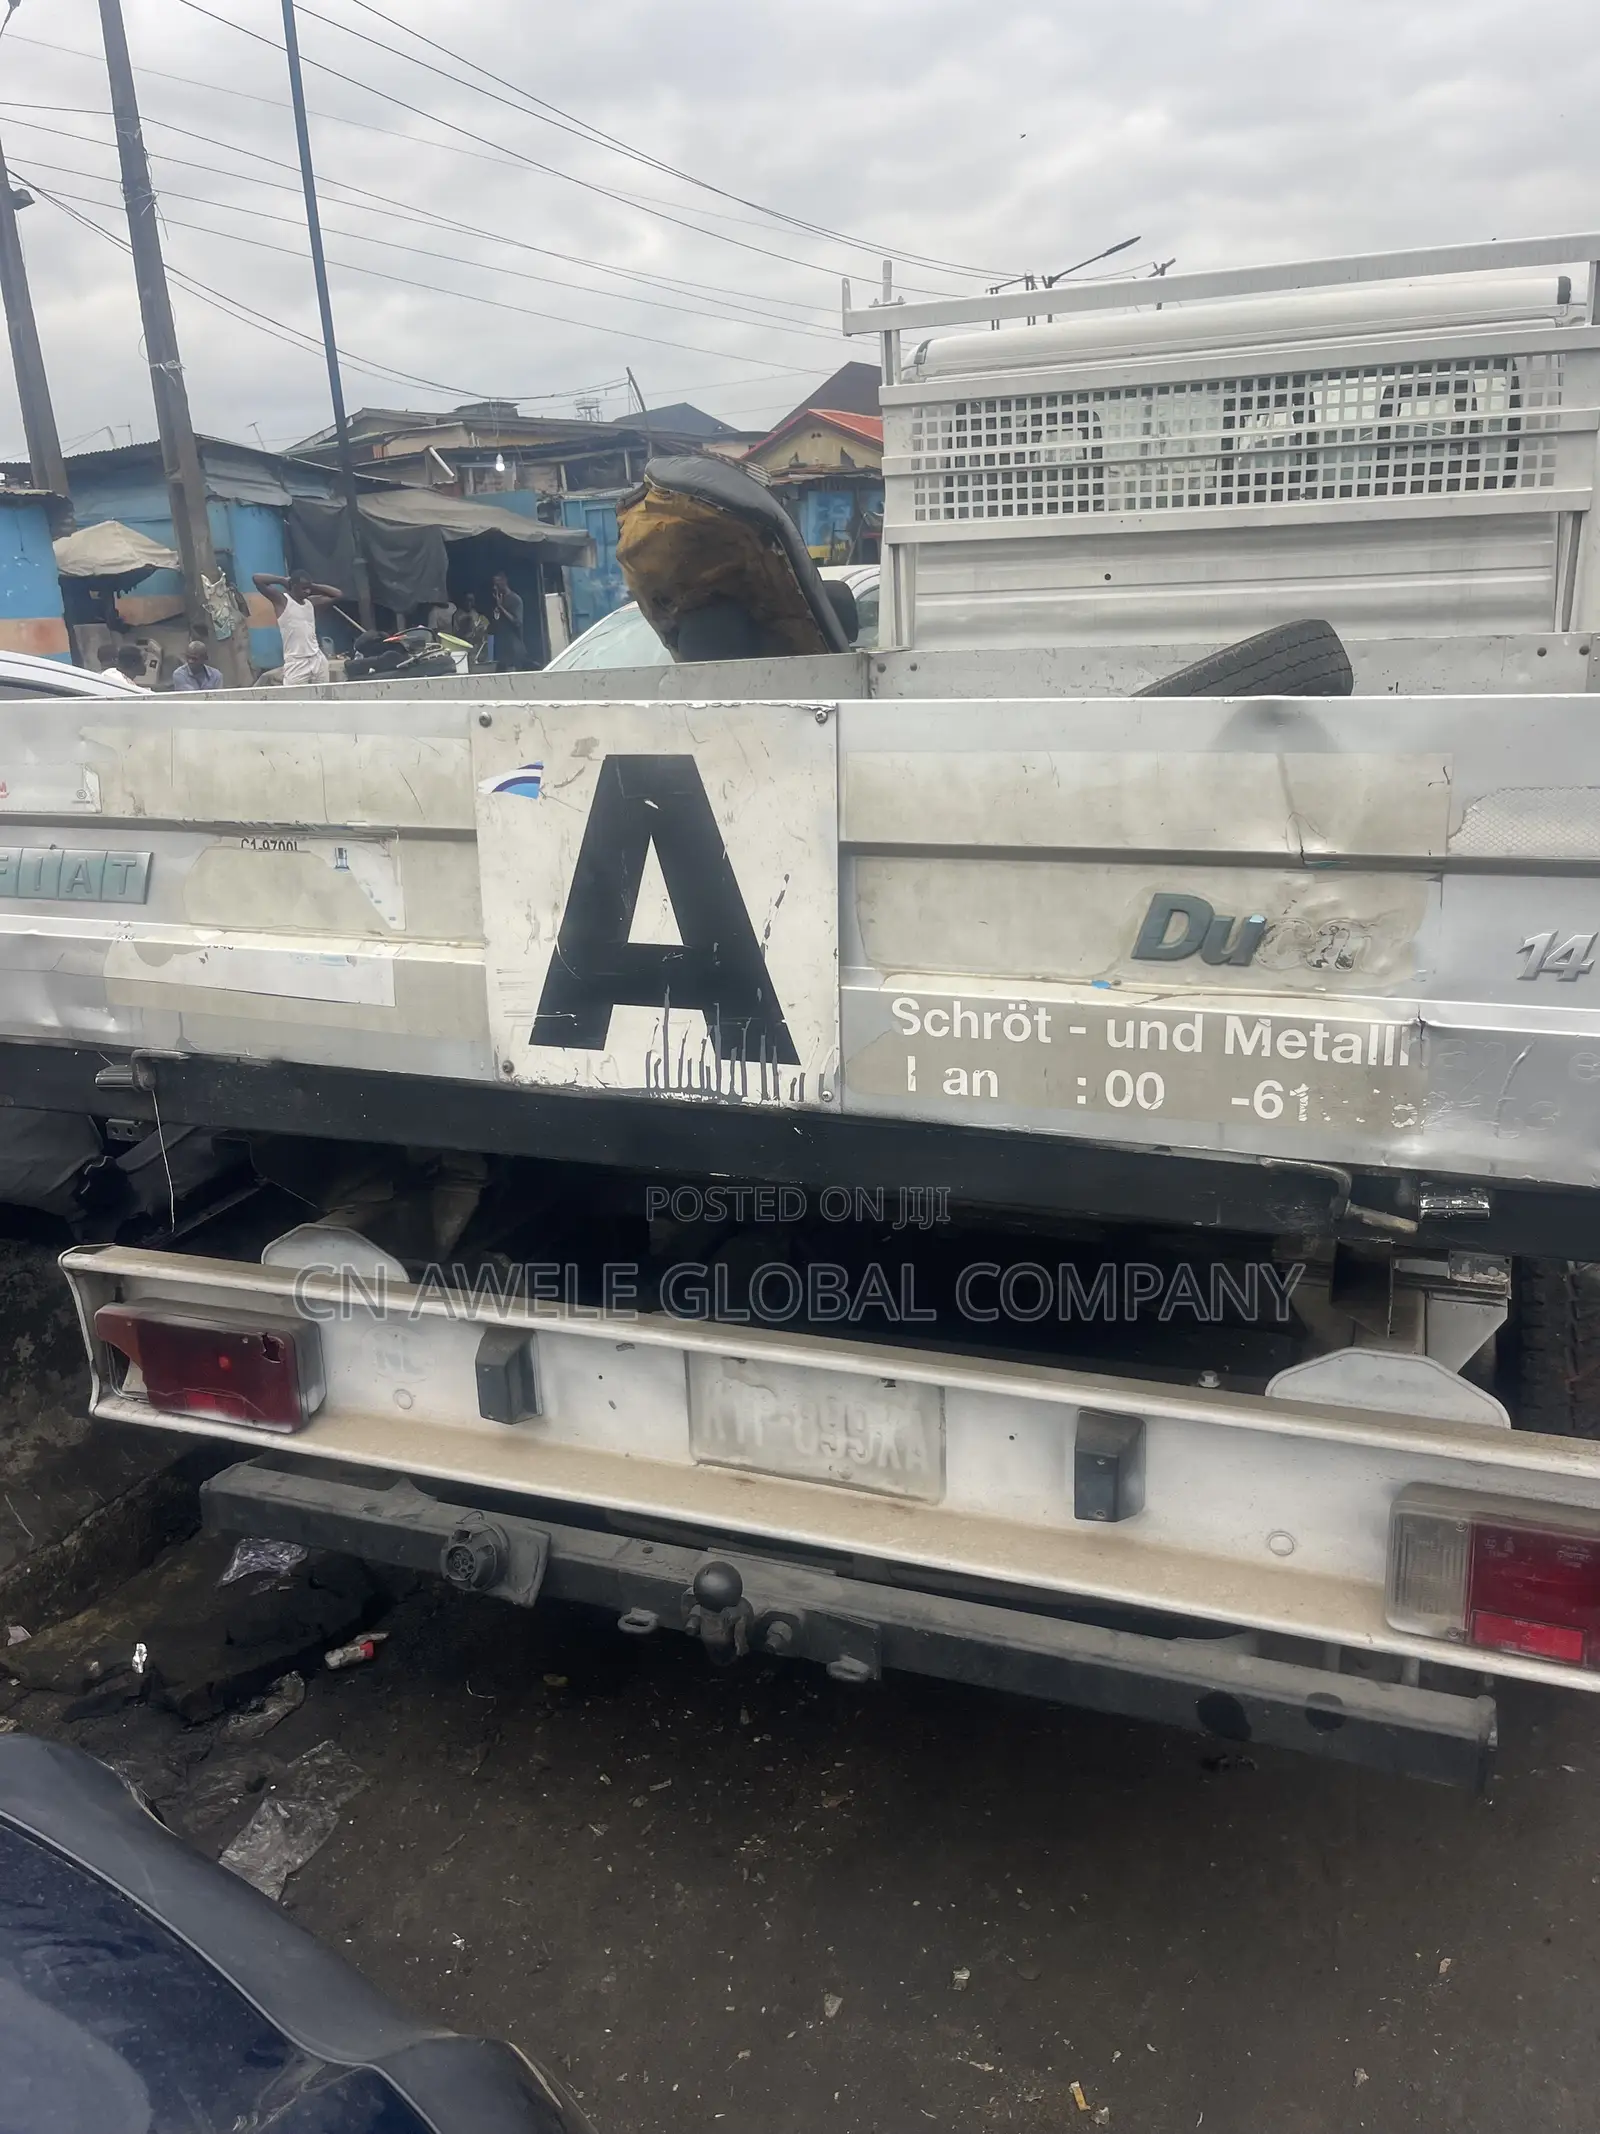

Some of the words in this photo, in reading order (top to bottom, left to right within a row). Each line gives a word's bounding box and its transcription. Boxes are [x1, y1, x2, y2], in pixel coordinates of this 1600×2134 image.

[528, 753, 802, 1066] A
[1516, 928, 1599, 982] 14
[1106, 1013, 1204, 1053] und
